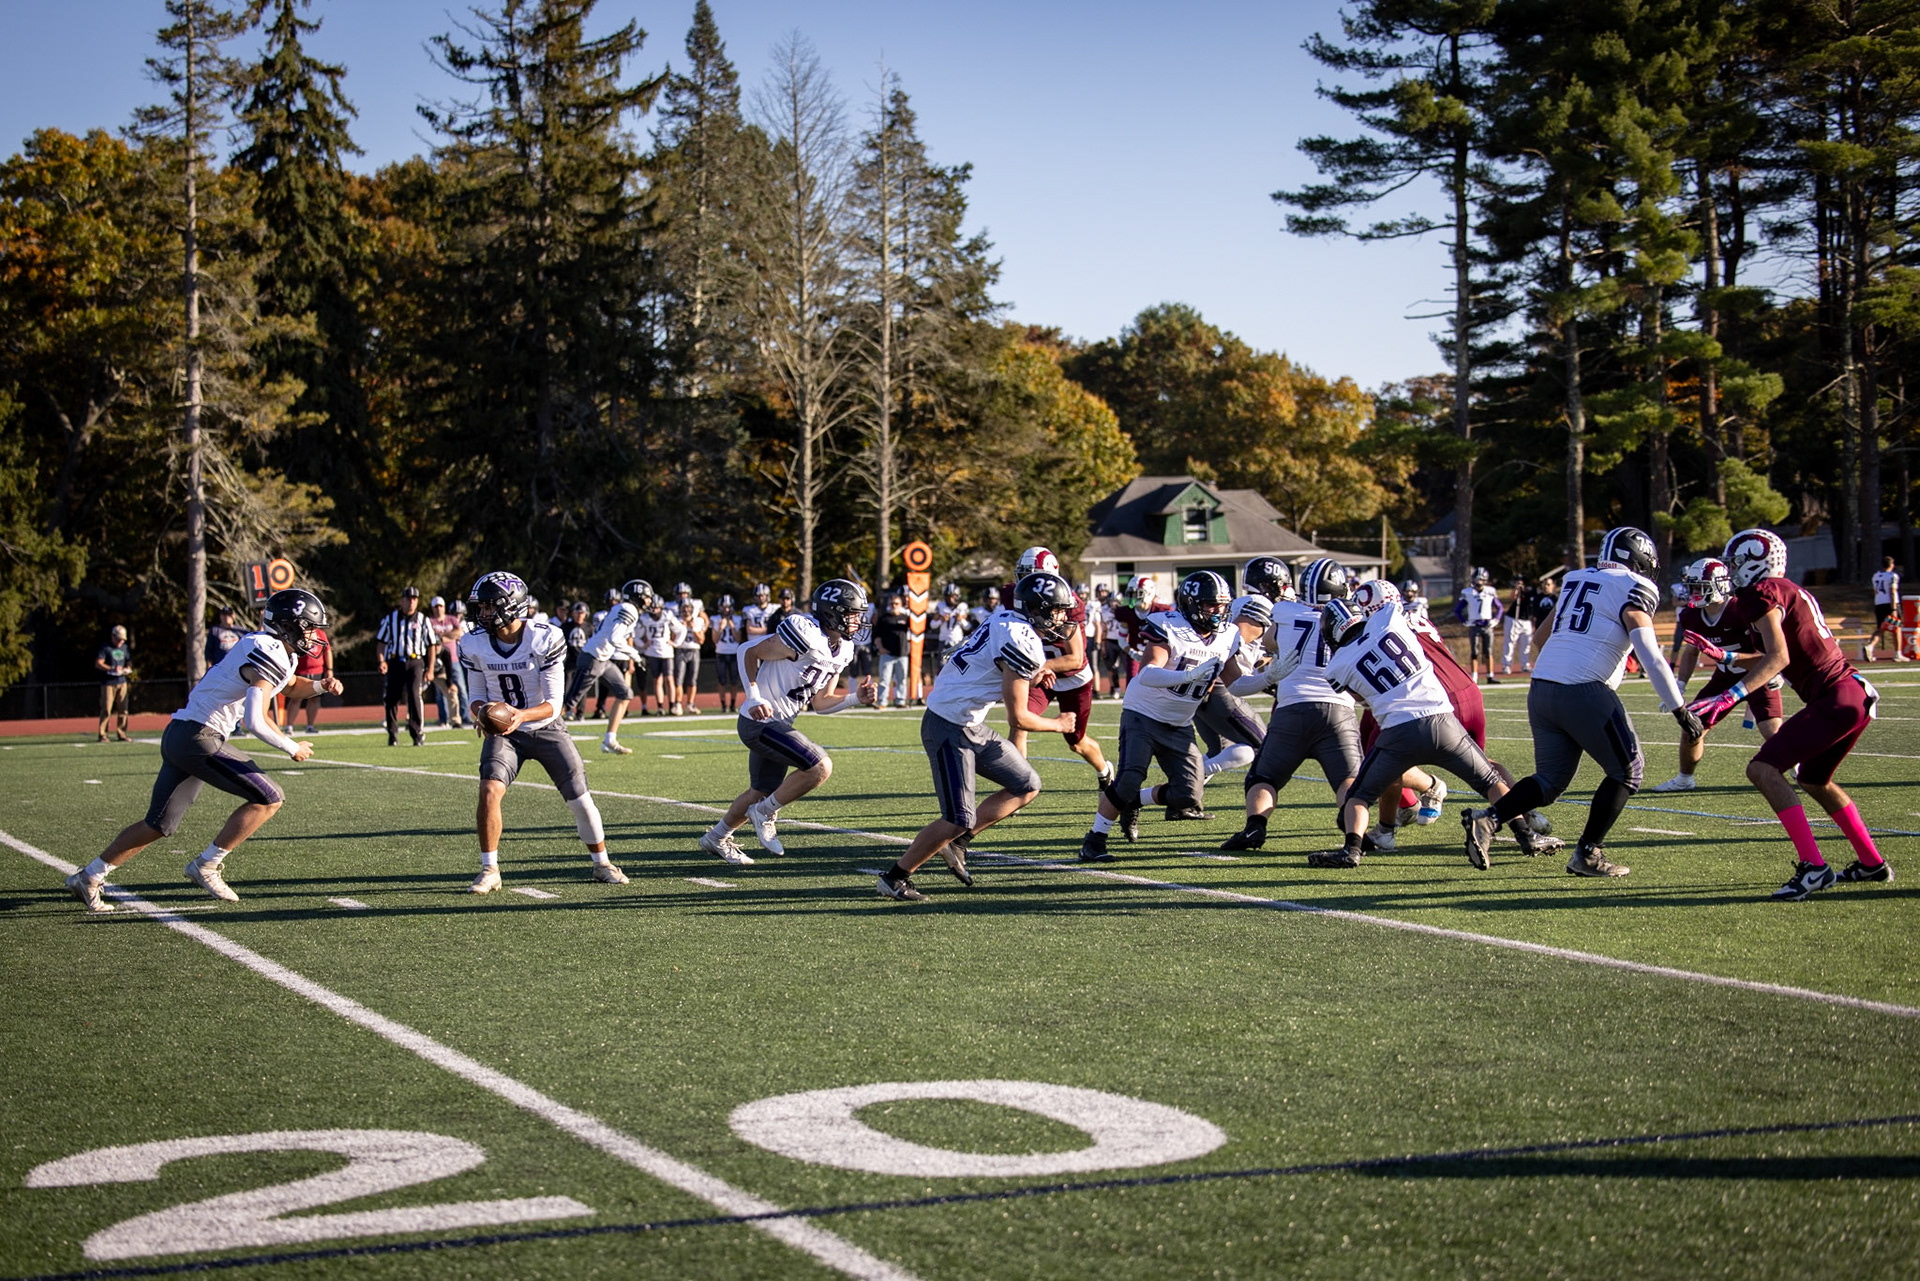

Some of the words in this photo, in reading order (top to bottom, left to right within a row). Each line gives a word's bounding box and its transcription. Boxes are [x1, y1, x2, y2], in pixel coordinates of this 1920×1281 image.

[252, 564, 265, 590] 1
[1264, 561, 1281, 577] 50
[633, 583, 643, 594] 16
[820, 586, 841, 603] 22
[1032, 577, 1056, 597] 32
[1182, 581, 1201, 597] 53
[292, 600, 306, 616] 3
[1553, 580, 1602, 635] 75
[486, 663, 509, 671] VALLEY
[511, 661, 528, 671] TECH
[1356, 631, 1422, 695] 68
[498, 673, 529, 710] 8
